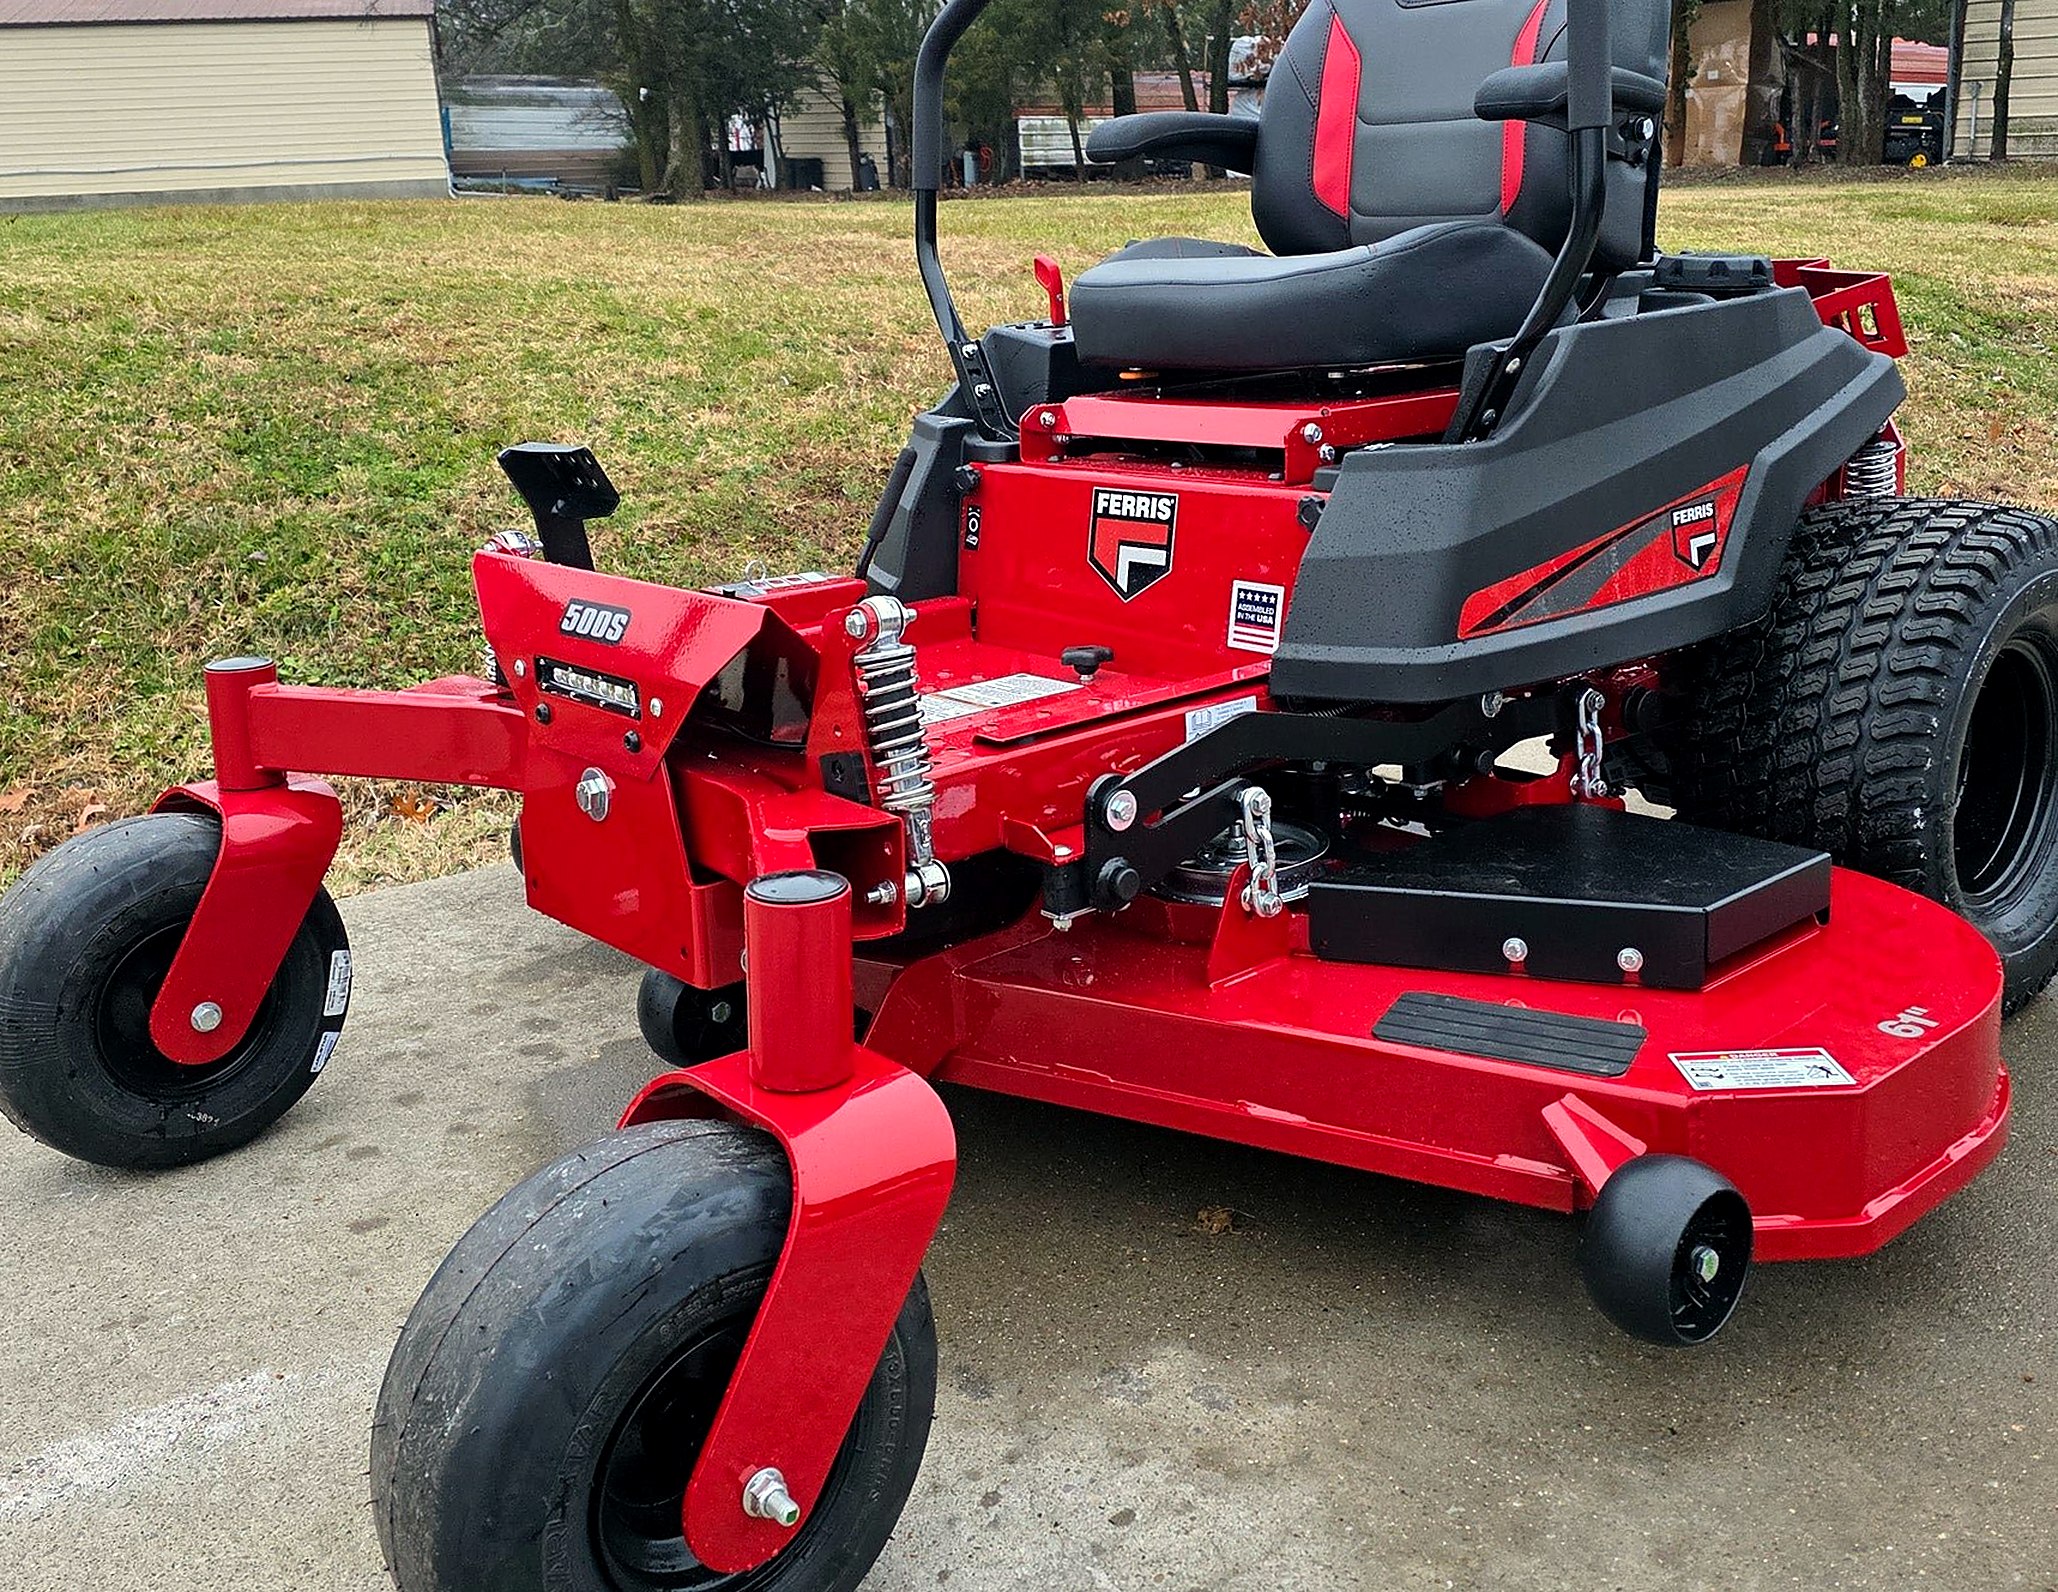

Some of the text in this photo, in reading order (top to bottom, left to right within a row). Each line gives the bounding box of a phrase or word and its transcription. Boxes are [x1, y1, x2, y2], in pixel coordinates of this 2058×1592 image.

[1097, 492, 1172, 520] FERRIS
[1673, 502, 1714, 526] FERRIS
[561, 603, 629, 642] 500S
[1257, 614, 1274, 625] USA
[1876, 1005, 1940, 1038] 61"
